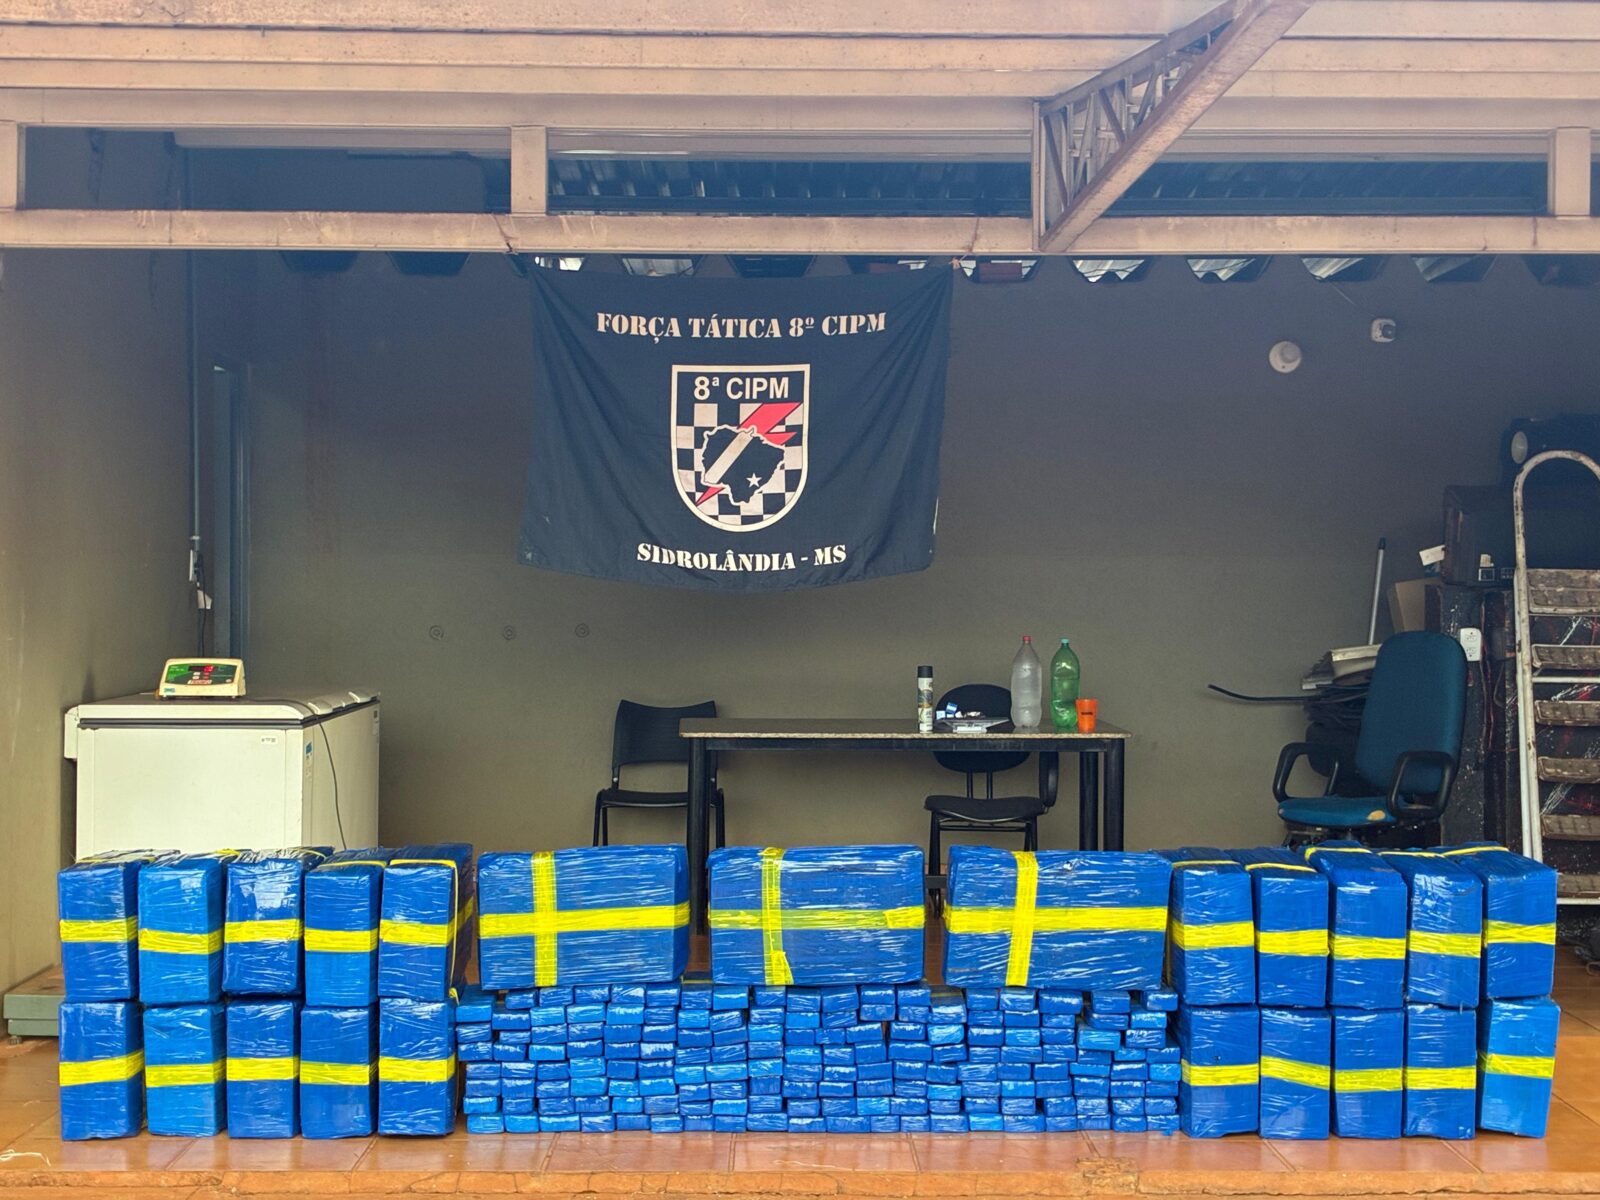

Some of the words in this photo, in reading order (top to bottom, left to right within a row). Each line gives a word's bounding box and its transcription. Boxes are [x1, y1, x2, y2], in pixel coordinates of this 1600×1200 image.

[596, 312, 682, 344] FORÇA
[688, 313, 782, 339] TÁTICA
[821, 312, 887, 336] CIPM
[693, 375, 720, 401] 8ª
[726, 376, 789, 400] CIPM
[637, 543, 796, 571] SIDROLÂNDIA
[813, 544, 847, 566] MS
